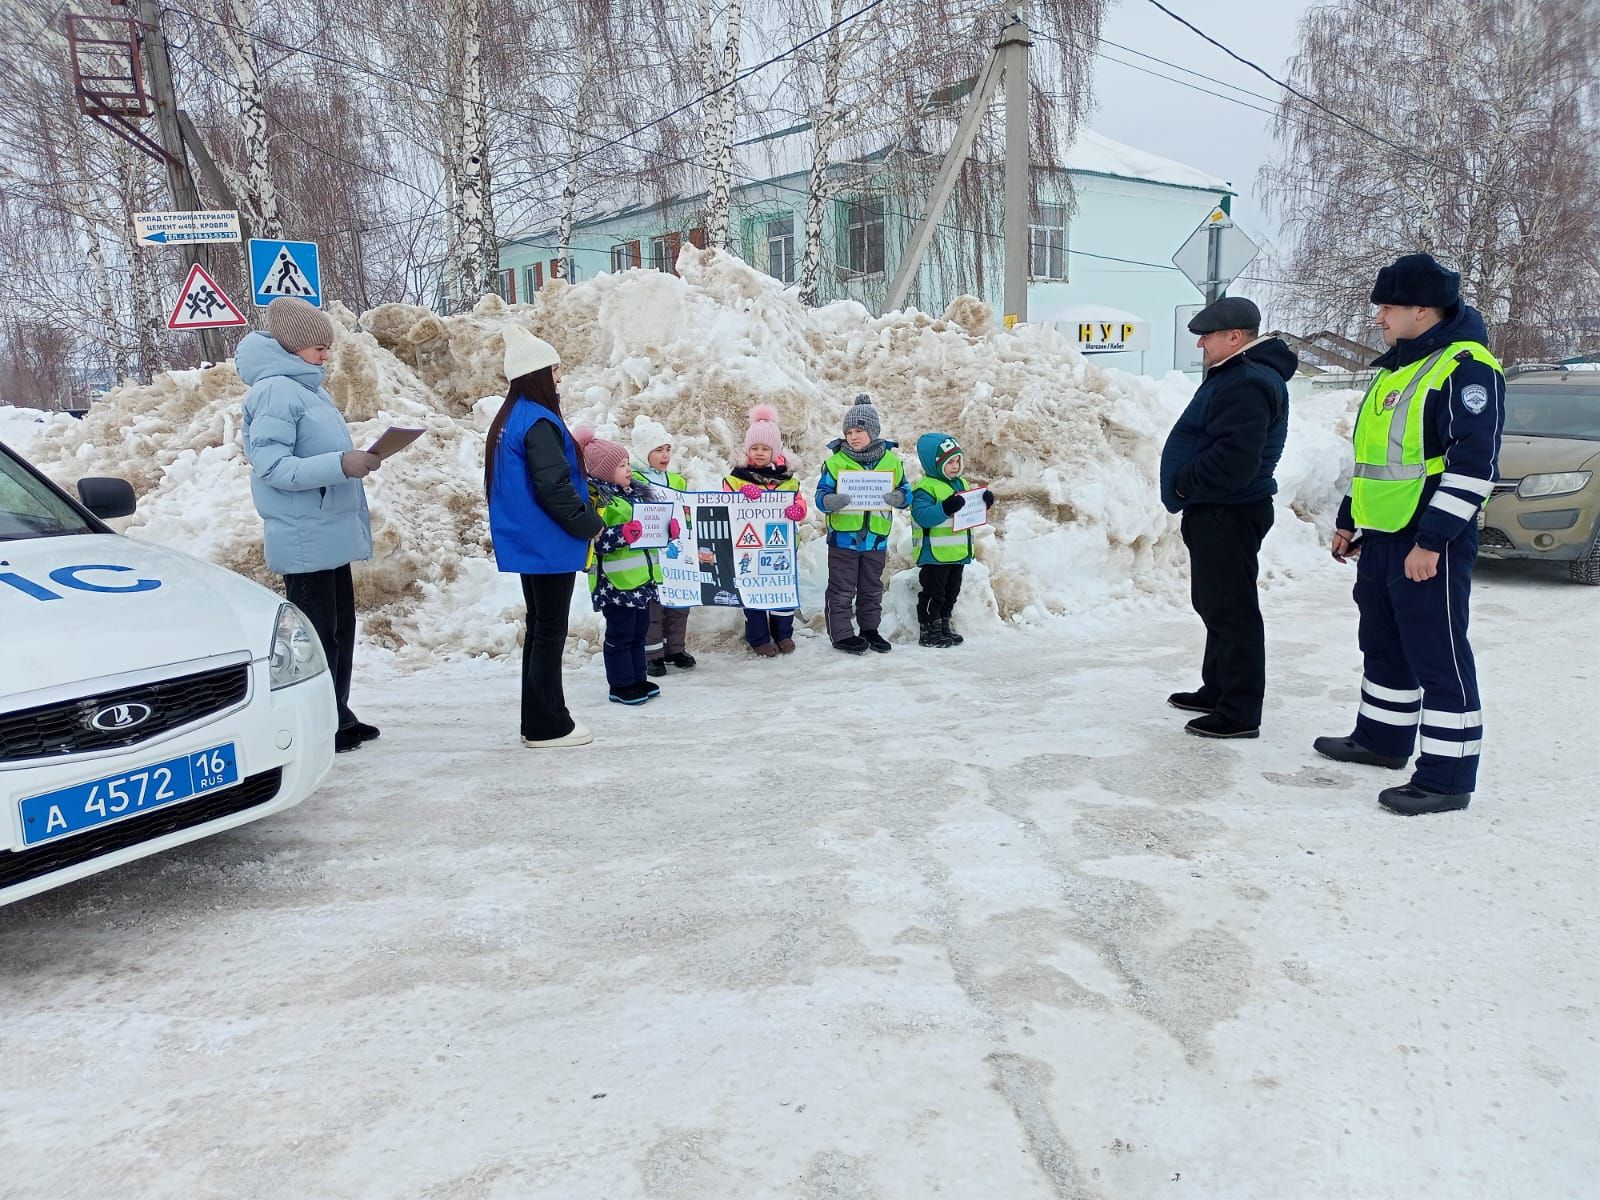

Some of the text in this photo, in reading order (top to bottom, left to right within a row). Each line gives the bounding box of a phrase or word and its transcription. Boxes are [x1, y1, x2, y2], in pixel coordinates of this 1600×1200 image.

[137, 215, 162, 223] СКЛАД
[146, 222, 177, 231] ЦЕМЕНТ
[200, 221, 229, 229] КРОВЛЯ
[1078, 323, 1135, 342] НУР
[760, 556, 772, 566] 02
[662, 566, 716, 586] ОДИТЕЛЬ,
[667, 588, 796, 604] ВСЕМ ЖИЗНЬ!
[200, 774, 224, 789] RUS
[45, 749, 225, 834] А 4572 16
